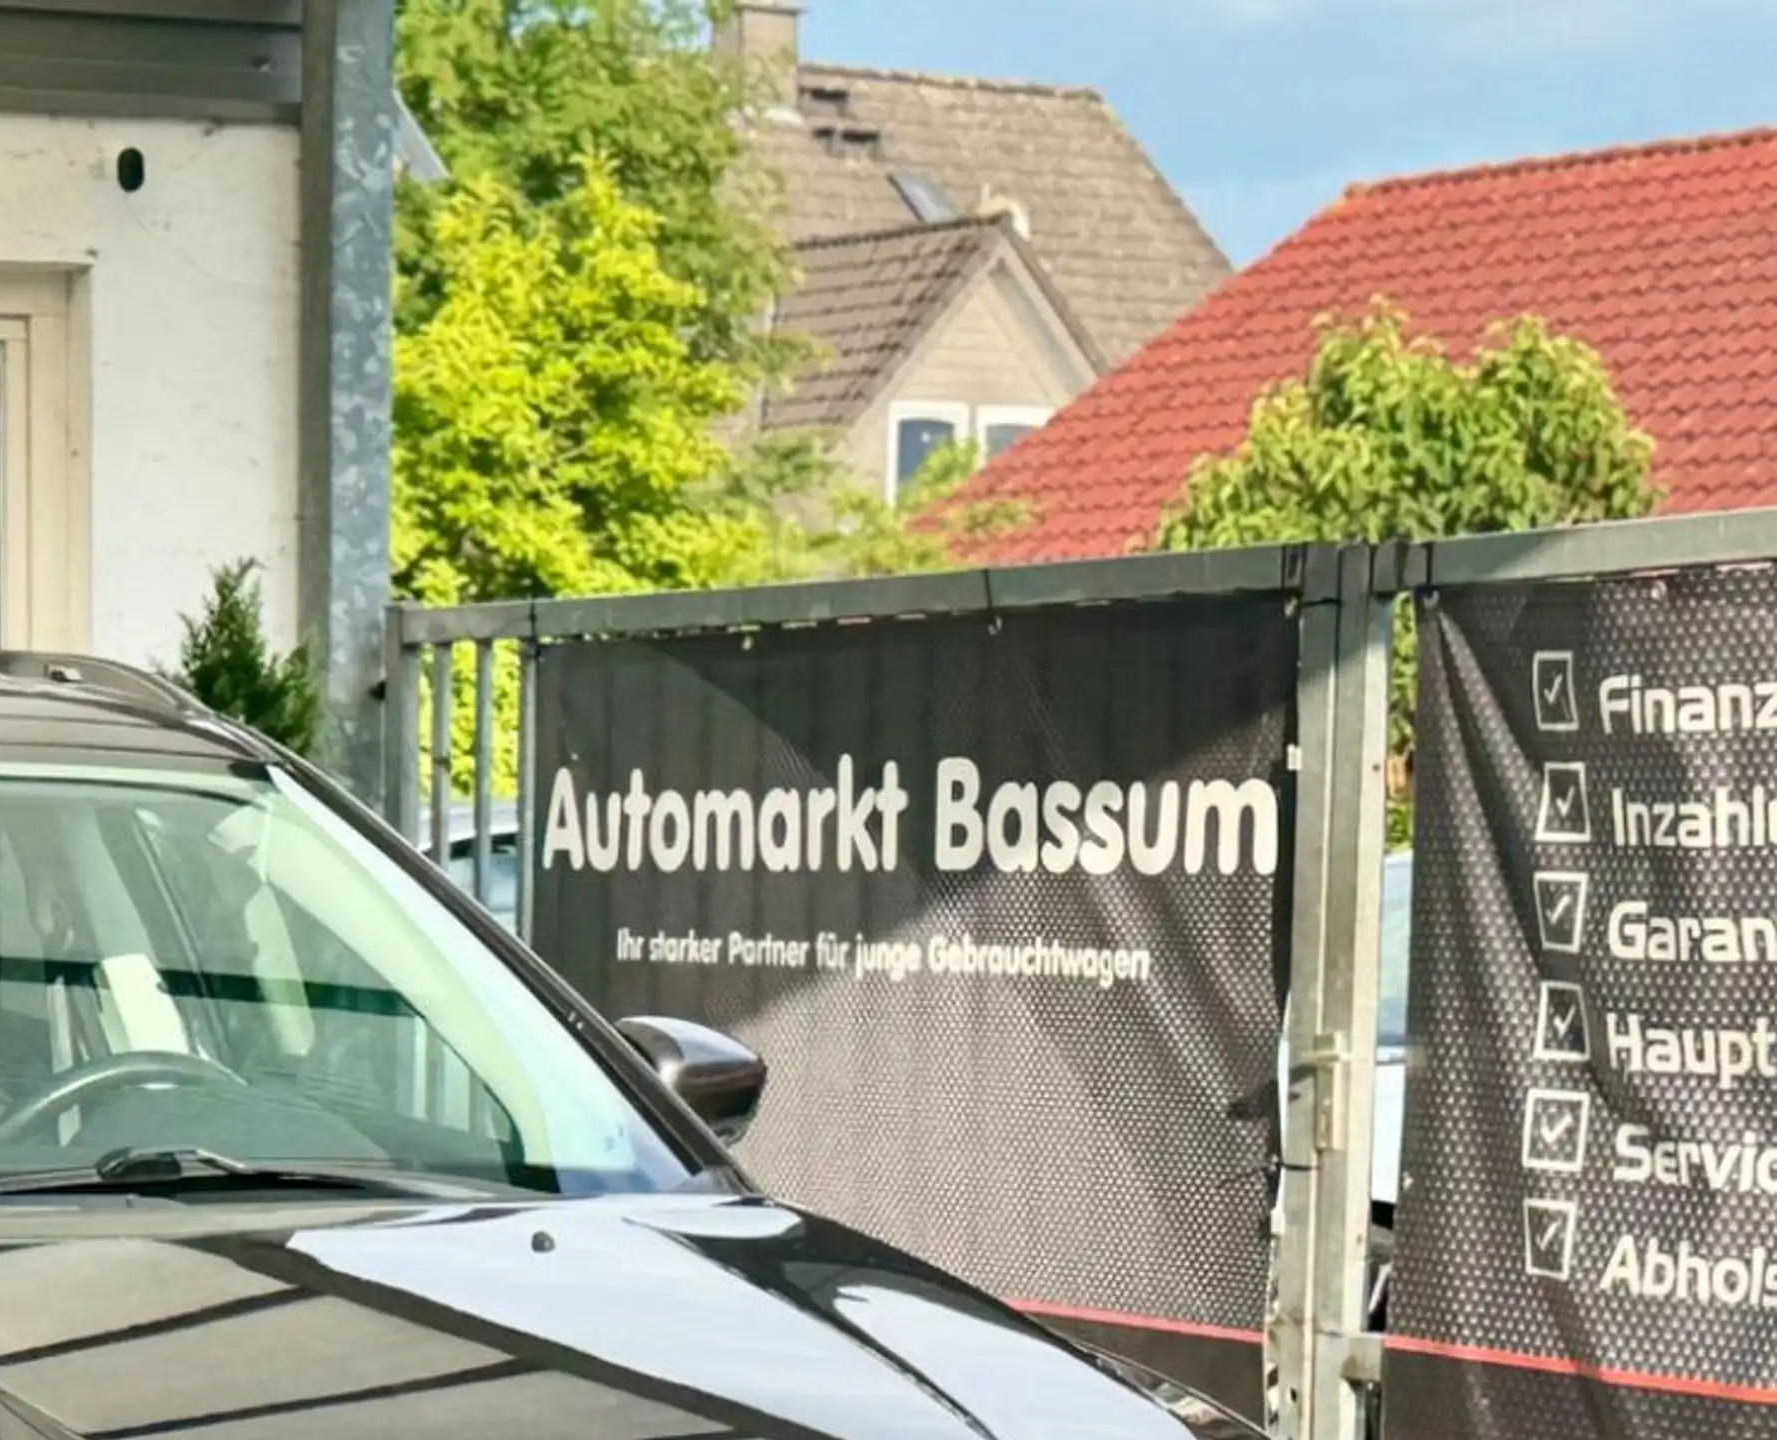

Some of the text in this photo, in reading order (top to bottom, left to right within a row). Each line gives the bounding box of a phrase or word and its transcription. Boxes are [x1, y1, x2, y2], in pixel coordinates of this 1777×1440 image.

[542, 753, 1277, 875] Automarkt Bassum
[617, 927, 1150, 988] Ihr starker Partner für junge Gebrauchtwagen
[1607, 1012, 1777, 1090] Haupt
